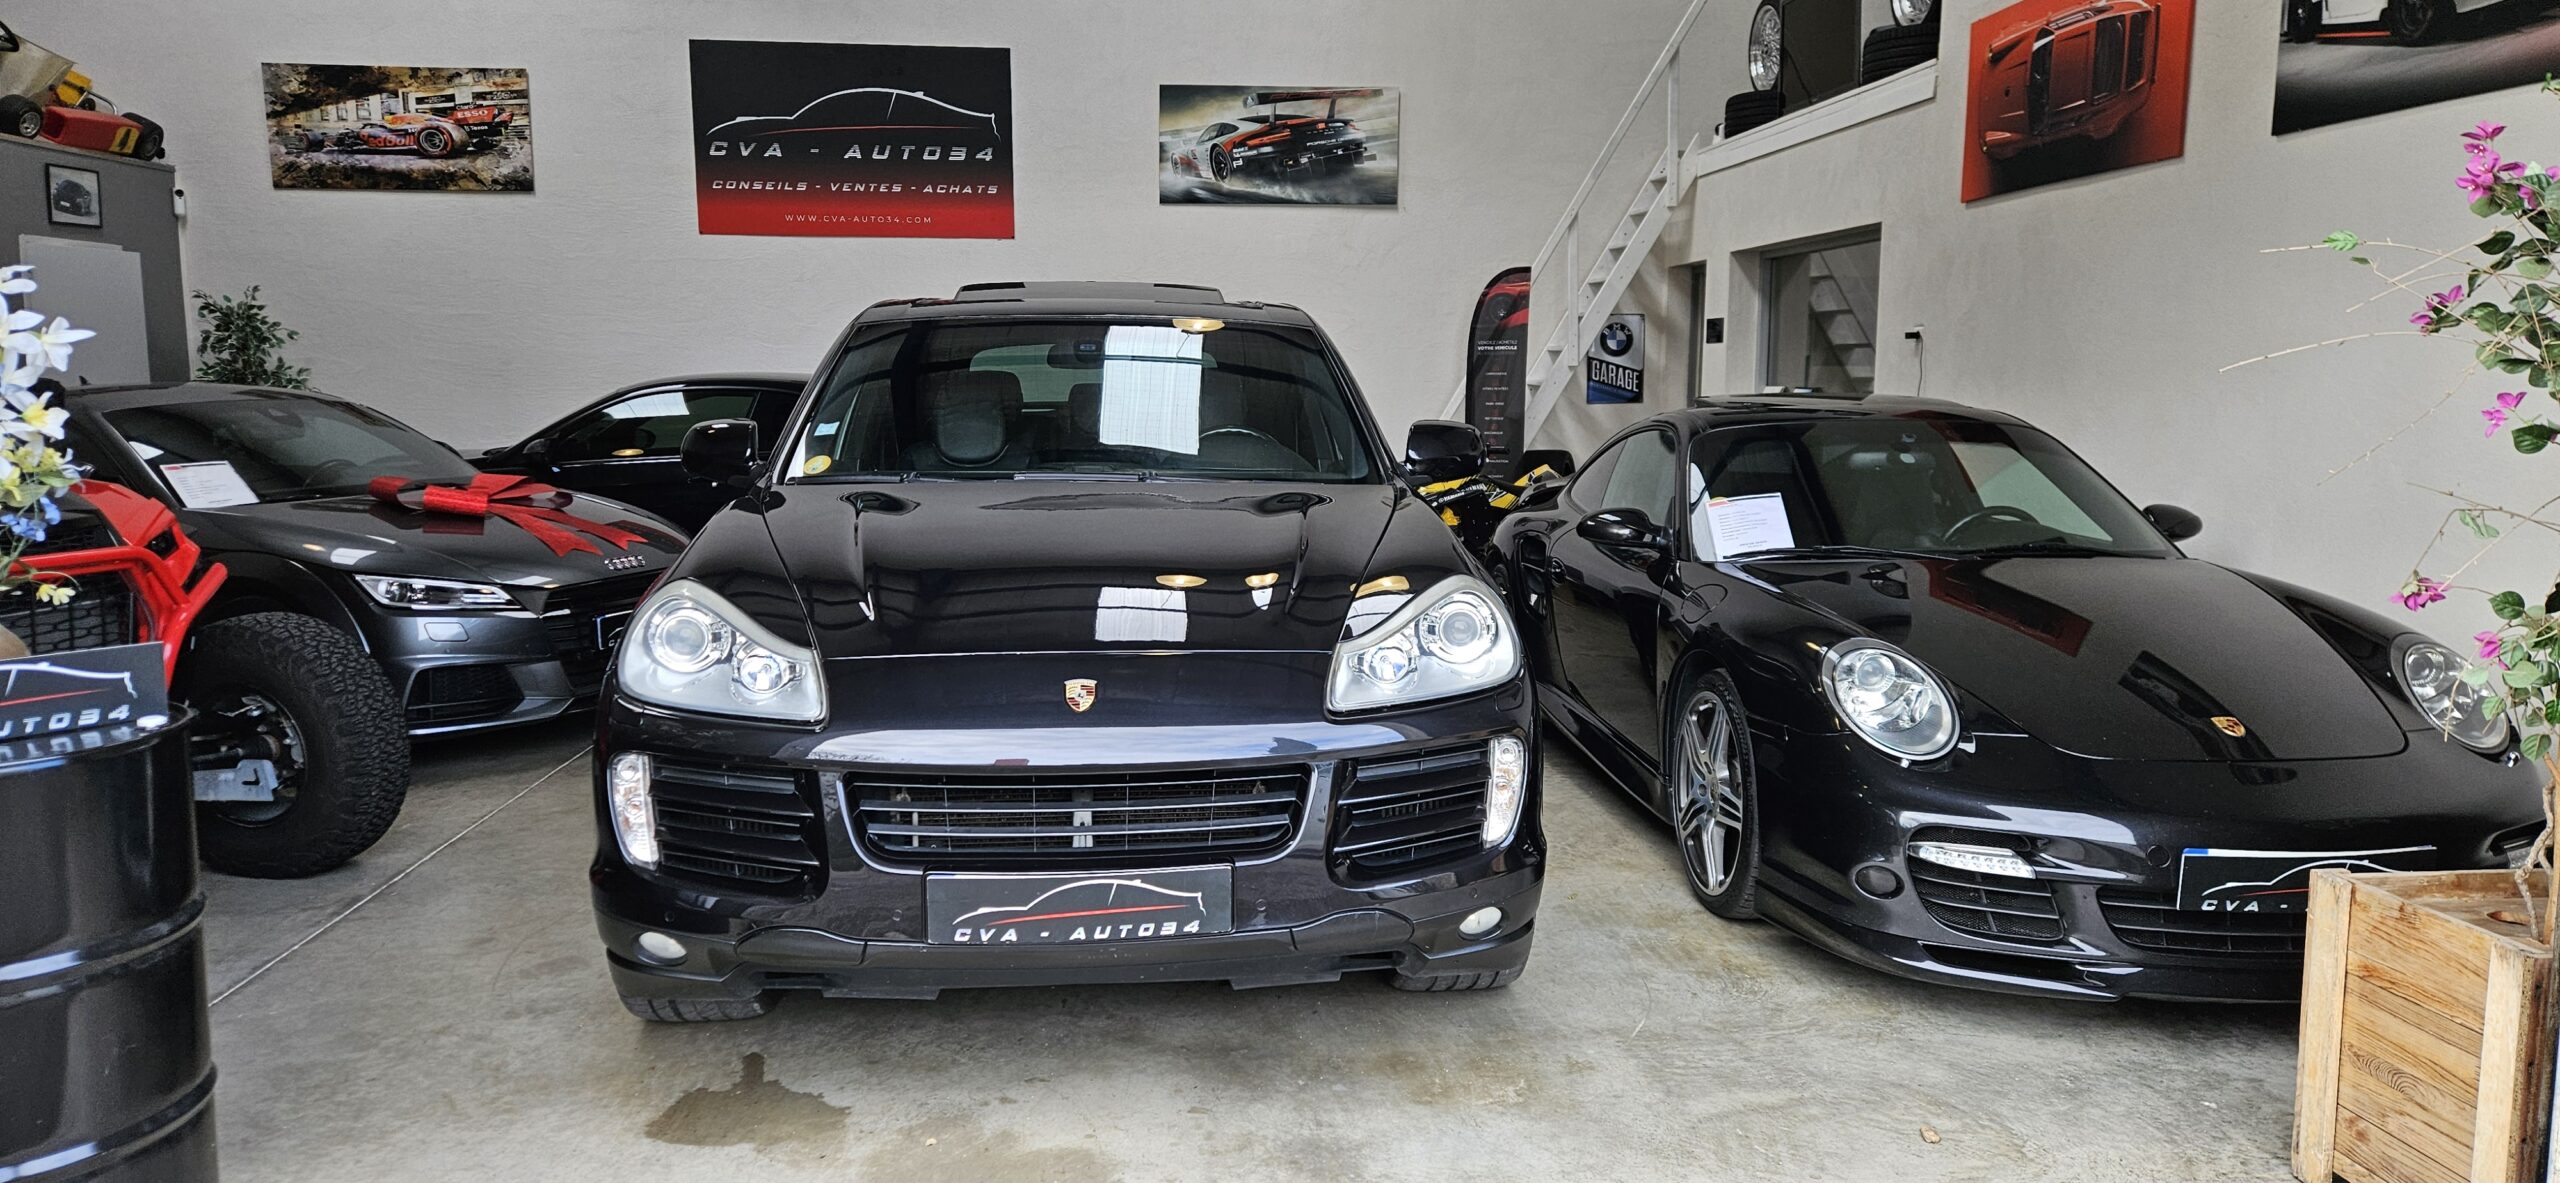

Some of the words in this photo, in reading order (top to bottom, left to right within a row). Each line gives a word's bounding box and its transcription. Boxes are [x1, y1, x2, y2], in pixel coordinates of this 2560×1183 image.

[457, 109, 488, 118] ESSO
[708, 141, 783, 157] CVA
[843, 144, 994, 161] AUTO34
[712, 180, 808, 191] CONSEILS
[830, 182, 903, 193] VENTES
[922, 184, 998, 194] ACHATS
[784, 214, 933, 224] WWW.CVA-AUTO34.COM
[1592, 360, 1640, 393] GARAGE
[2201, 900, 2260, 912] CVA
[953, 928, 1018, 942] CVA
[1069, 920, 1200, 941] AUTO34
